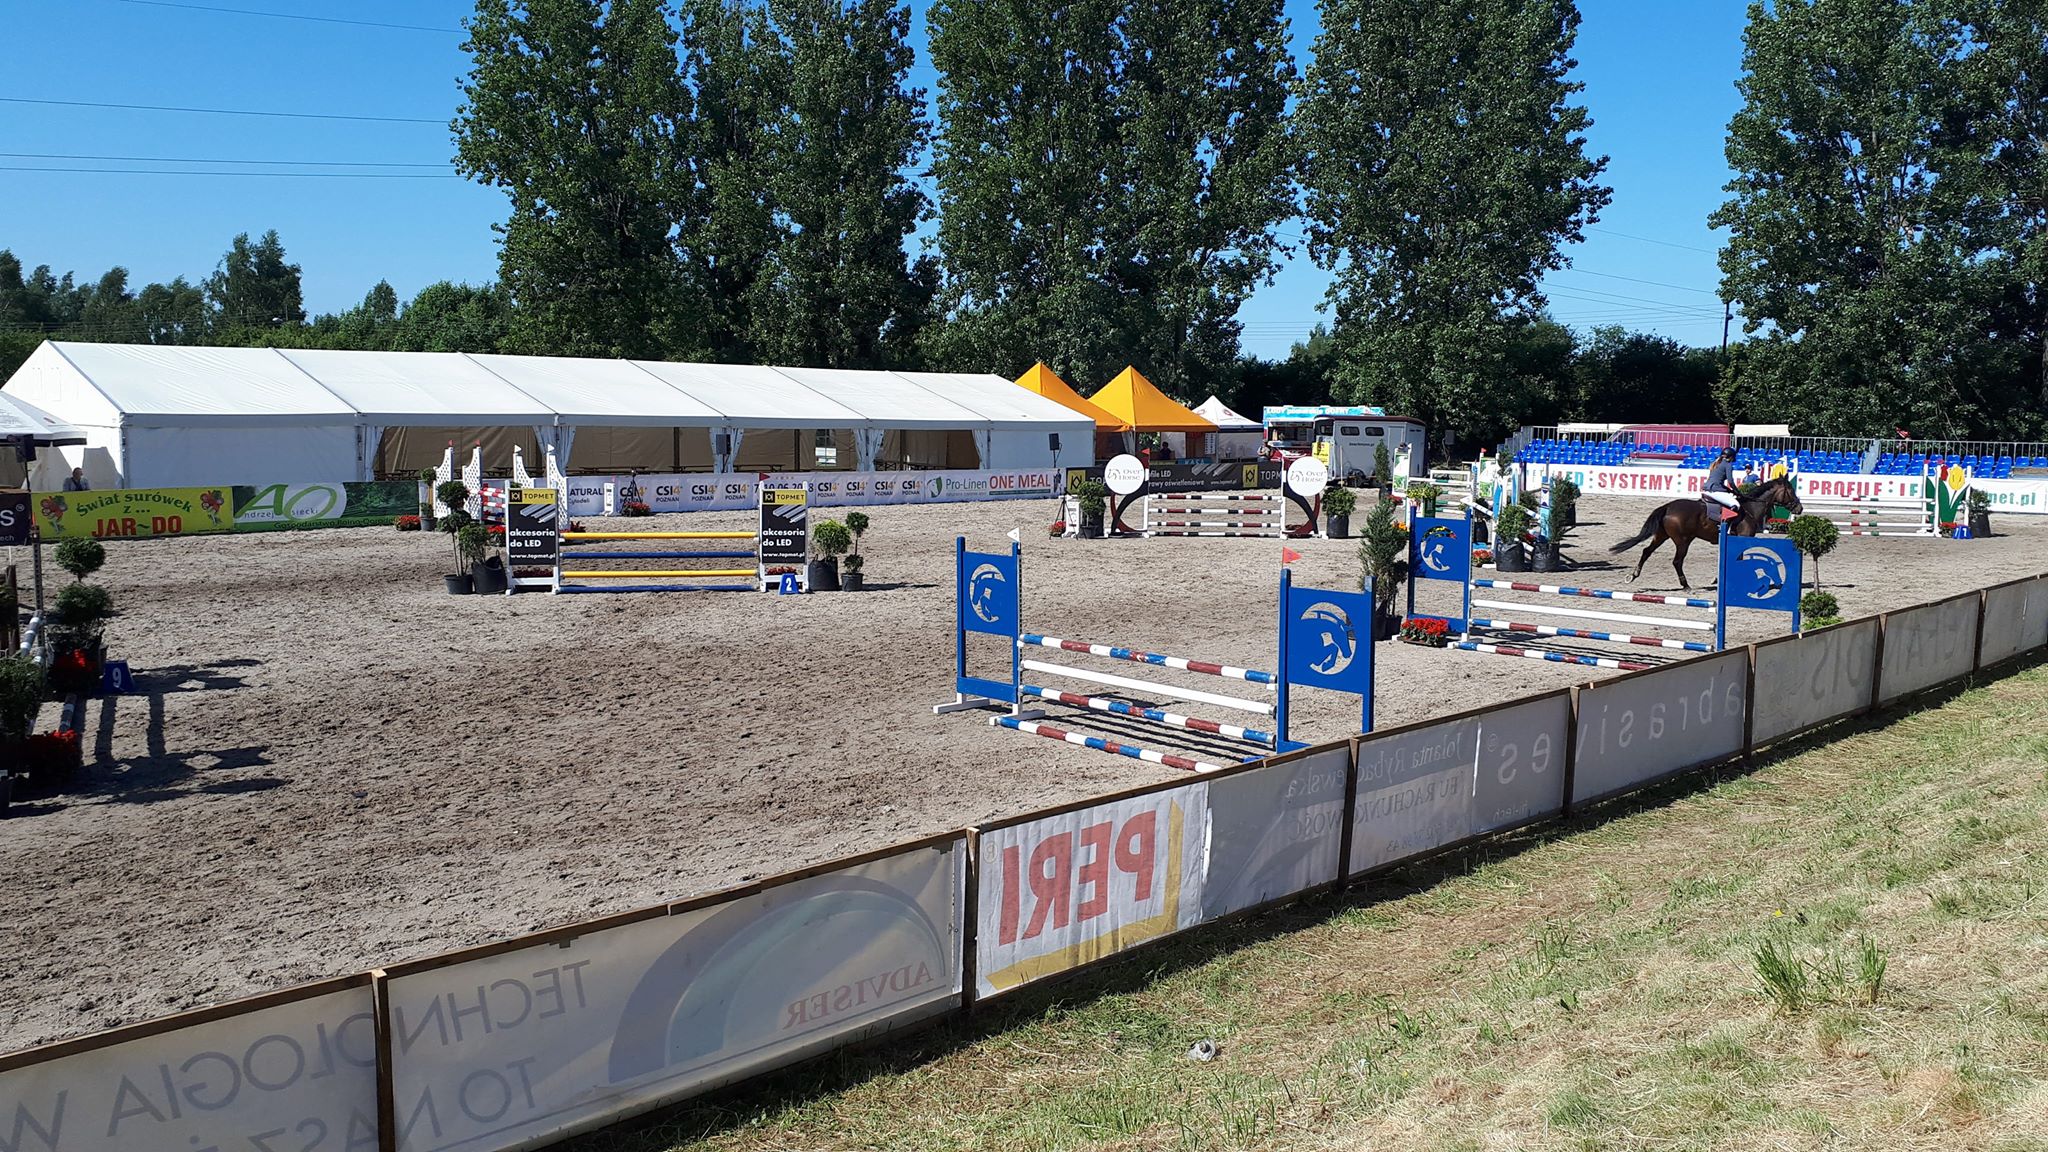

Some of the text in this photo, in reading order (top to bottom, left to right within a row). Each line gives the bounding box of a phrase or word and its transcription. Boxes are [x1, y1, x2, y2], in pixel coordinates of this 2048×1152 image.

[1260, 470, 1281, 481] TOPM
[945, 474, 1051, 491] Pro-Linen ONE MEAL
[1598, 472, 1673, 491] SYSTEMY
[569, 488, 604, 496] ATURAL
[76, 491, 193, 517] Świat surówek
[123, 505, 131, 514] z
[509, 528, 555, 537] akcesoria
[762, 528, 805, 536] akcesoria
[509, 539, 542, 548] do LED
[762, 538, 792, 547] do LED
[510, 552, 556, 560] www.topmet.pl
[785, 577, 792, 592] 2
[112, 667, 122, 688] 9
